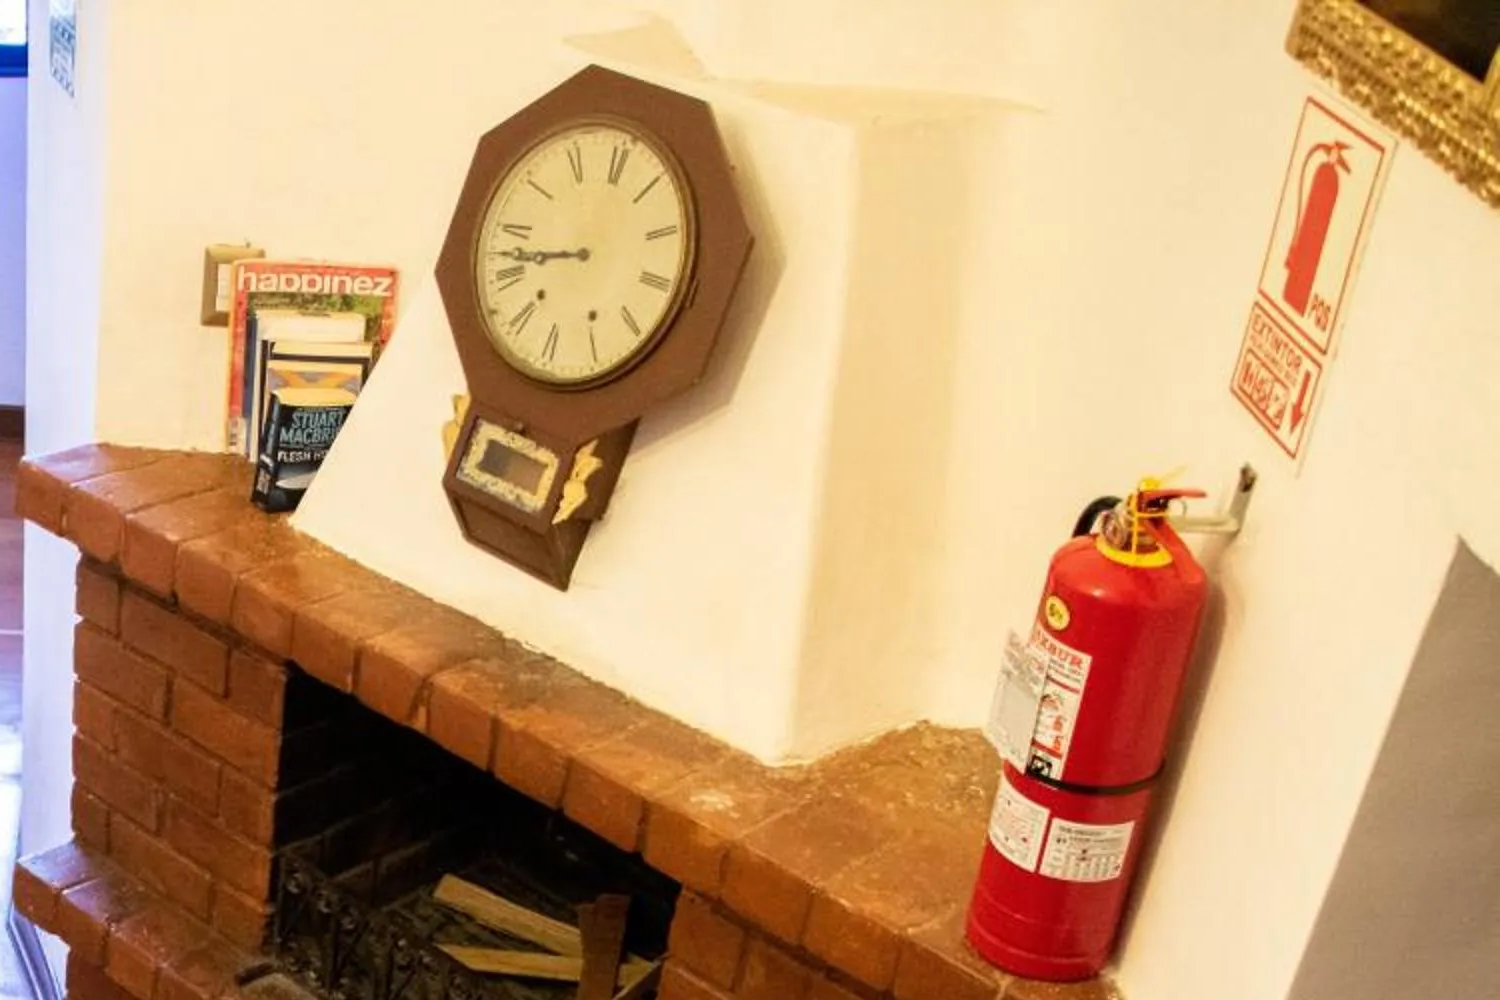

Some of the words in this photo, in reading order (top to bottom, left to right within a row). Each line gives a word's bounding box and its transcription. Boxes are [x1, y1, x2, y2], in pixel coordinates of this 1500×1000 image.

[237, 264, 393, 297] happinez
[291, 411, 345, 429] STUART
[279, 426, 340, 447] MACBRI
[277, 450, 311, 463] FLESH
